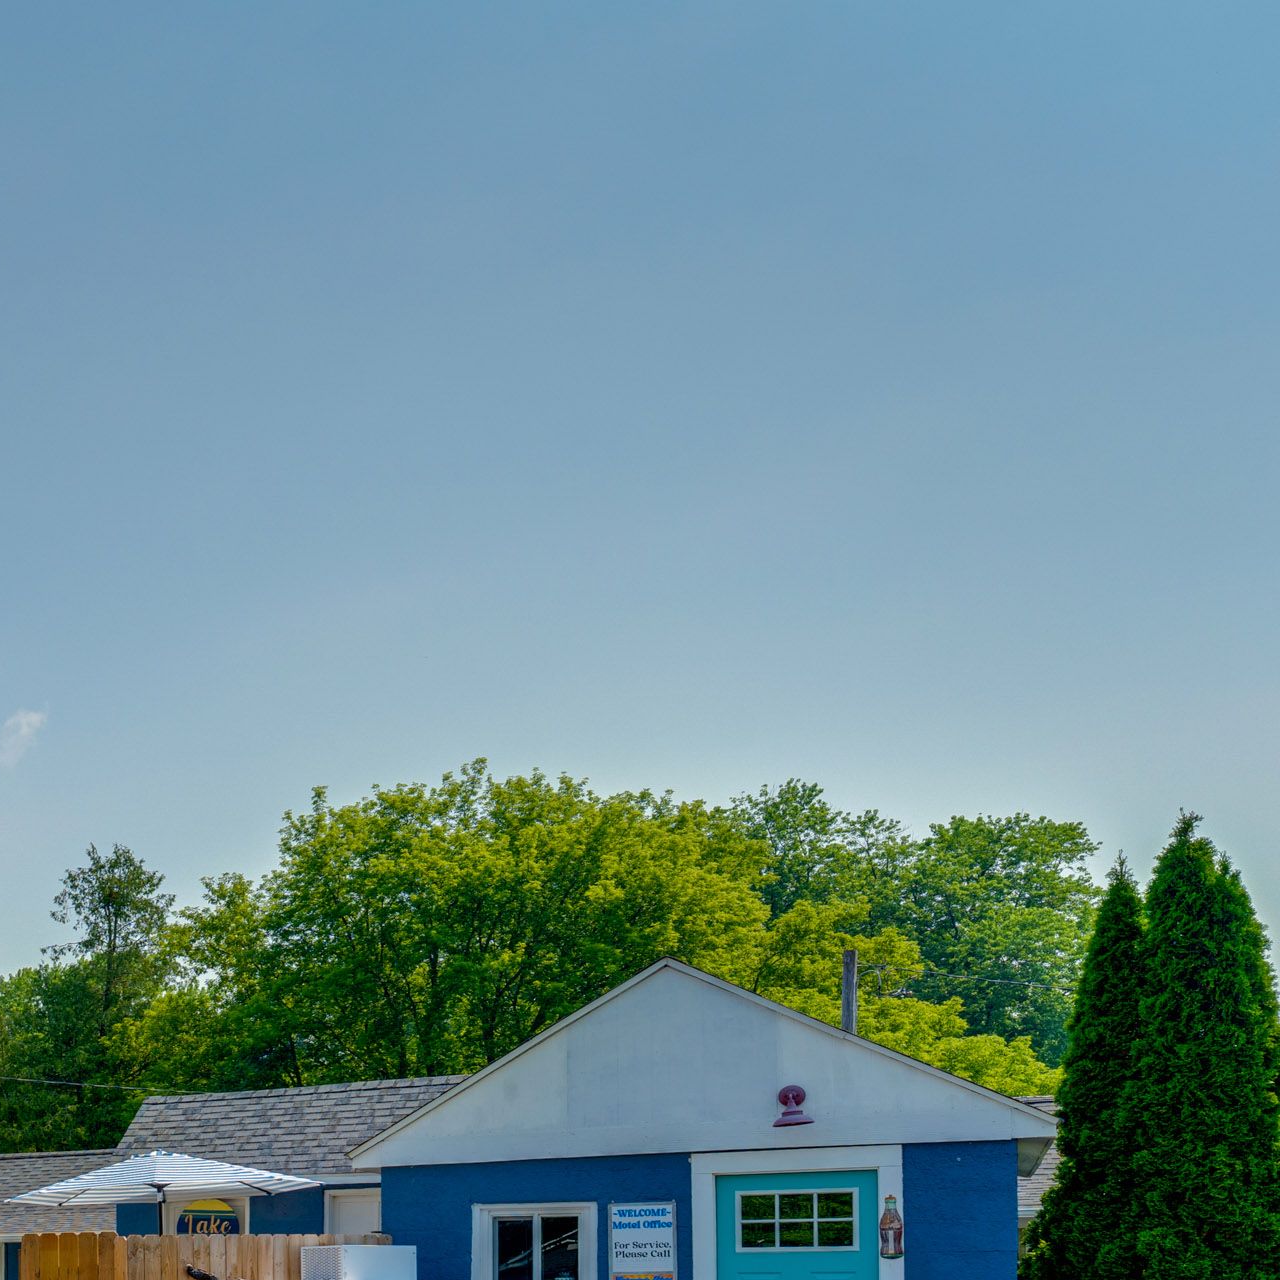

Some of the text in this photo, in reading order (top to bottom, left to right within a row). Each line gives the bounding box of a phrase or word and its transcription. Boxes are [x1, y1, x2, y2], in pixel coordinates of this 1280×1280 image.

[612, 1220, 672, 1230] Motel Office
[614, 1241, 630, 1250] For
[615, 1249, 671, 1259] Please Call
